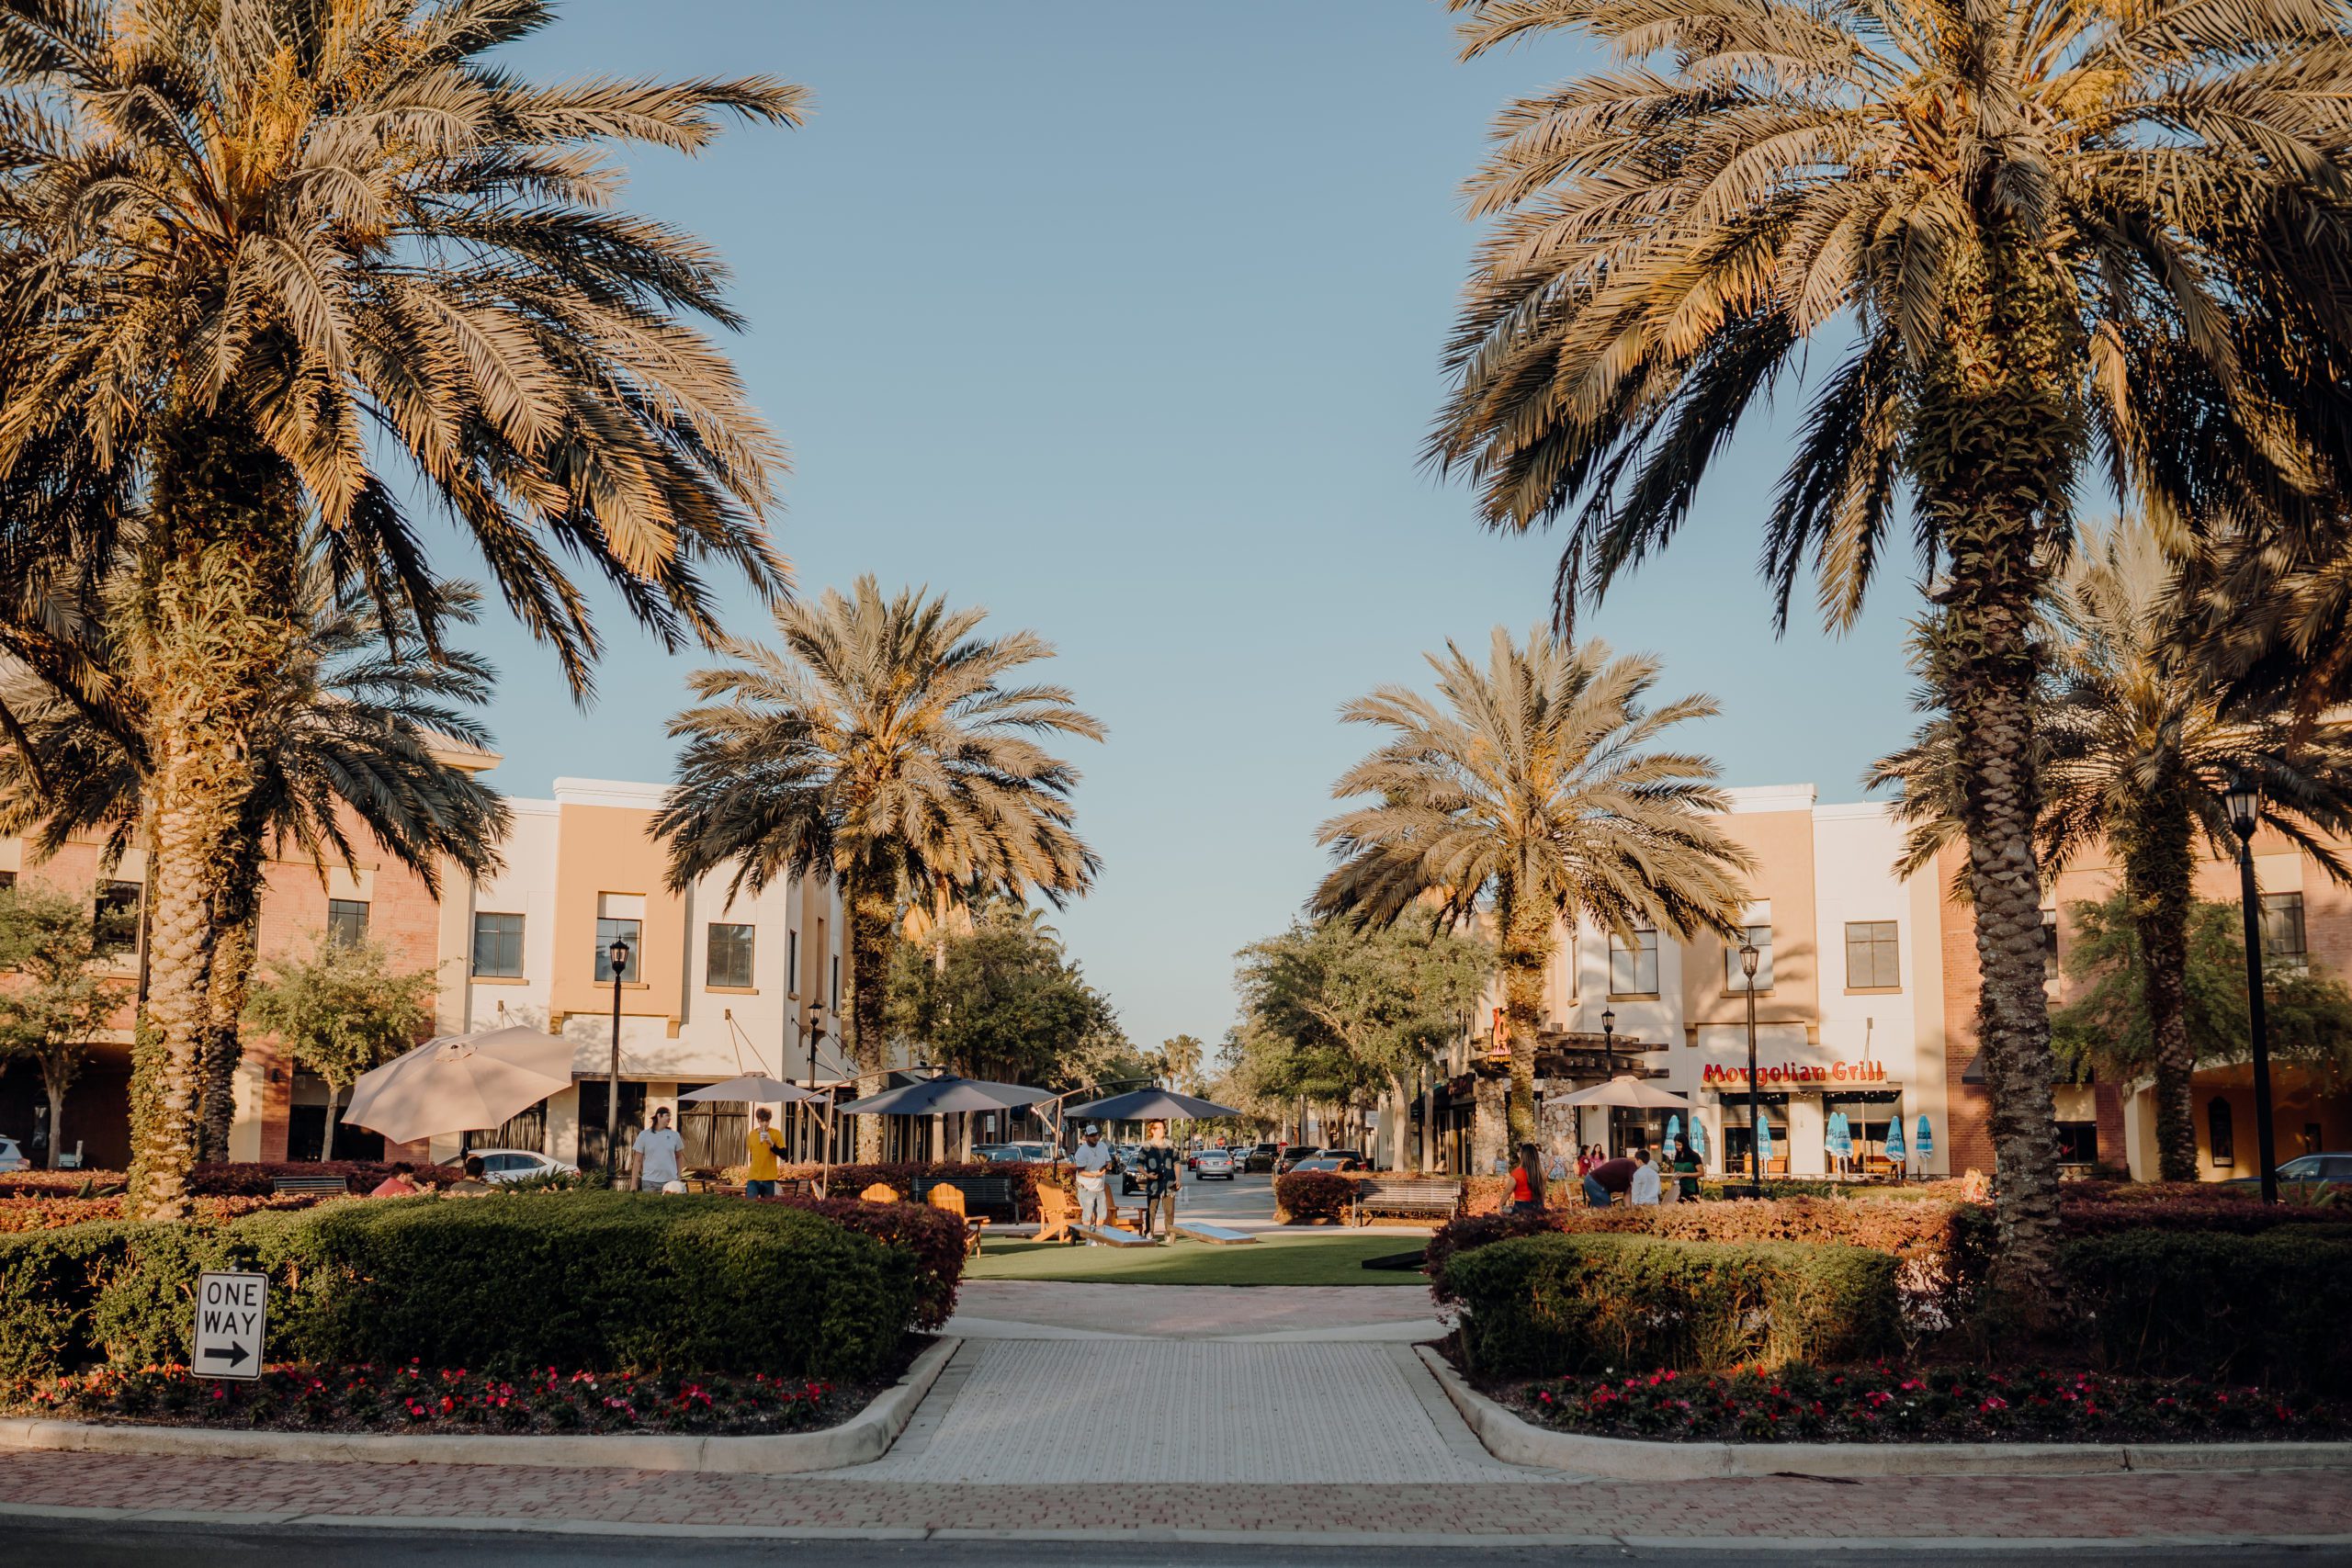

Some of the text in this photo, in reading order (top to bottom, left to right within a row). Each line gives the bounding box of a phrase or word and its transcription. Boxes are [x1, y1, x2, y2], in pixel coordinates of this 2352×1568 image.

[1702, 1060, 1884, 1087] Mongolian Grill
[208, 1281, 258, 1306] ONE
[204, 1310, 257, 1336] WAY
